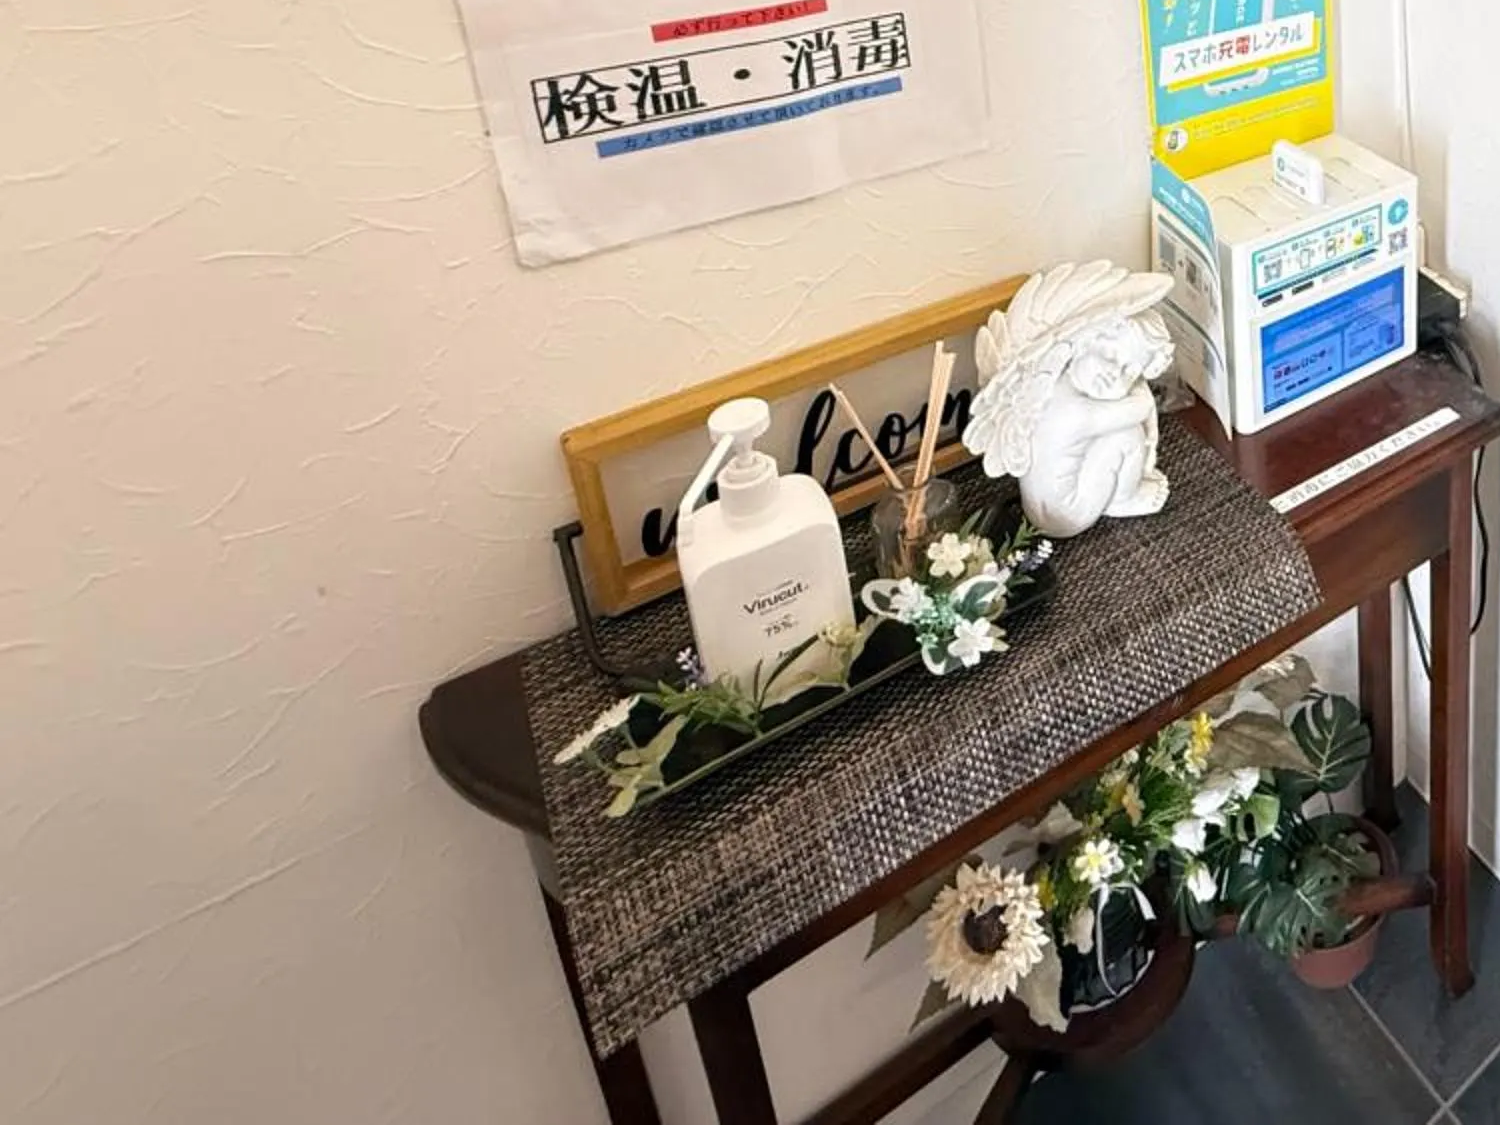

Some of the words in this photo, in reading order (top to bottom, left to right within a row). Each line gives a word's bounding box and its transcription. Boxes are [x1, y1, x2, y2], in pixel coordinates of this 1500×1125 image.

[1173, 23, 1304, 74] スマホ充電レンタル
[543, 19, 907, 138] 検温・消毒
[743, 582, 803, 615] Virucut
